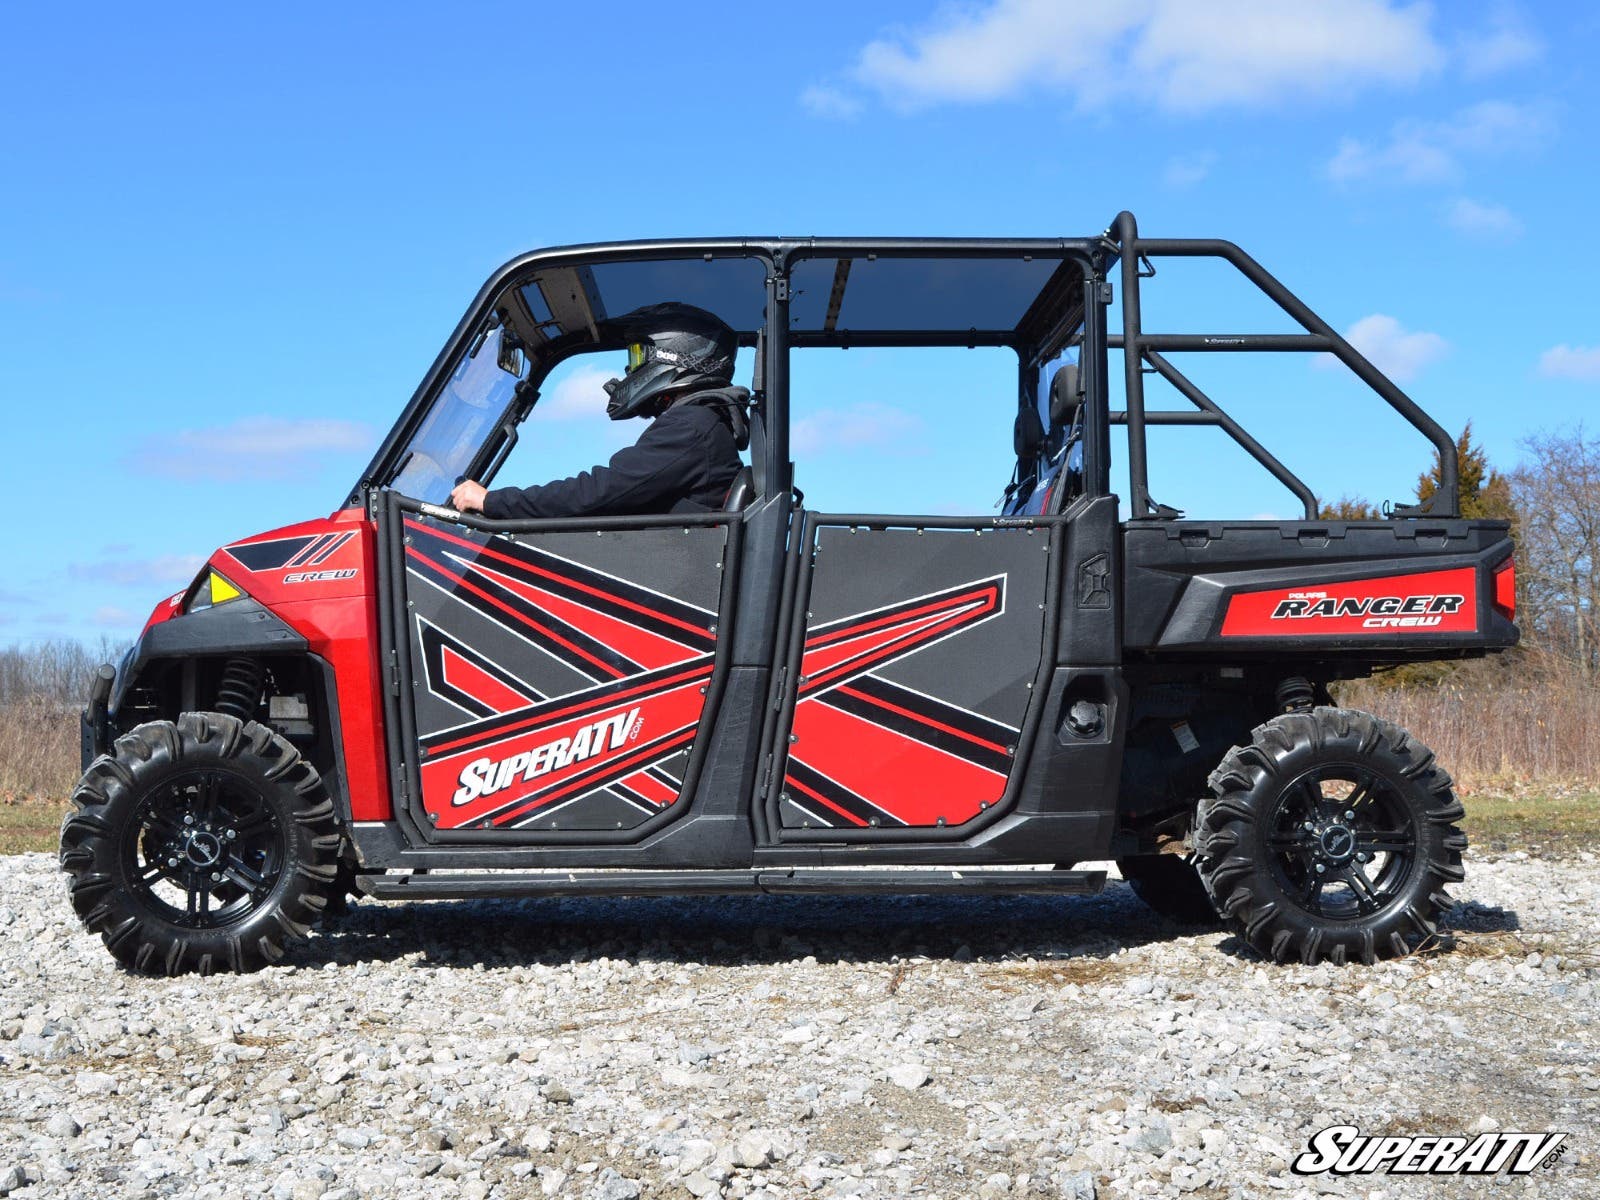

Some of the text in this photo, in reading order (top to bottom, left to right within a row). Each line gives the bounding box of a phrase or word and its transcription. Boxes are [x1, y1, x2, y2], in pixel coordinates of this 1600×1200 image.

[283, 568, 358, 584] CREW
[1289, 592, 1327, 600] POLARIS
[1270, 595, 1465, 619] RANGER
[1362, 616, 1442, 627] CREW
